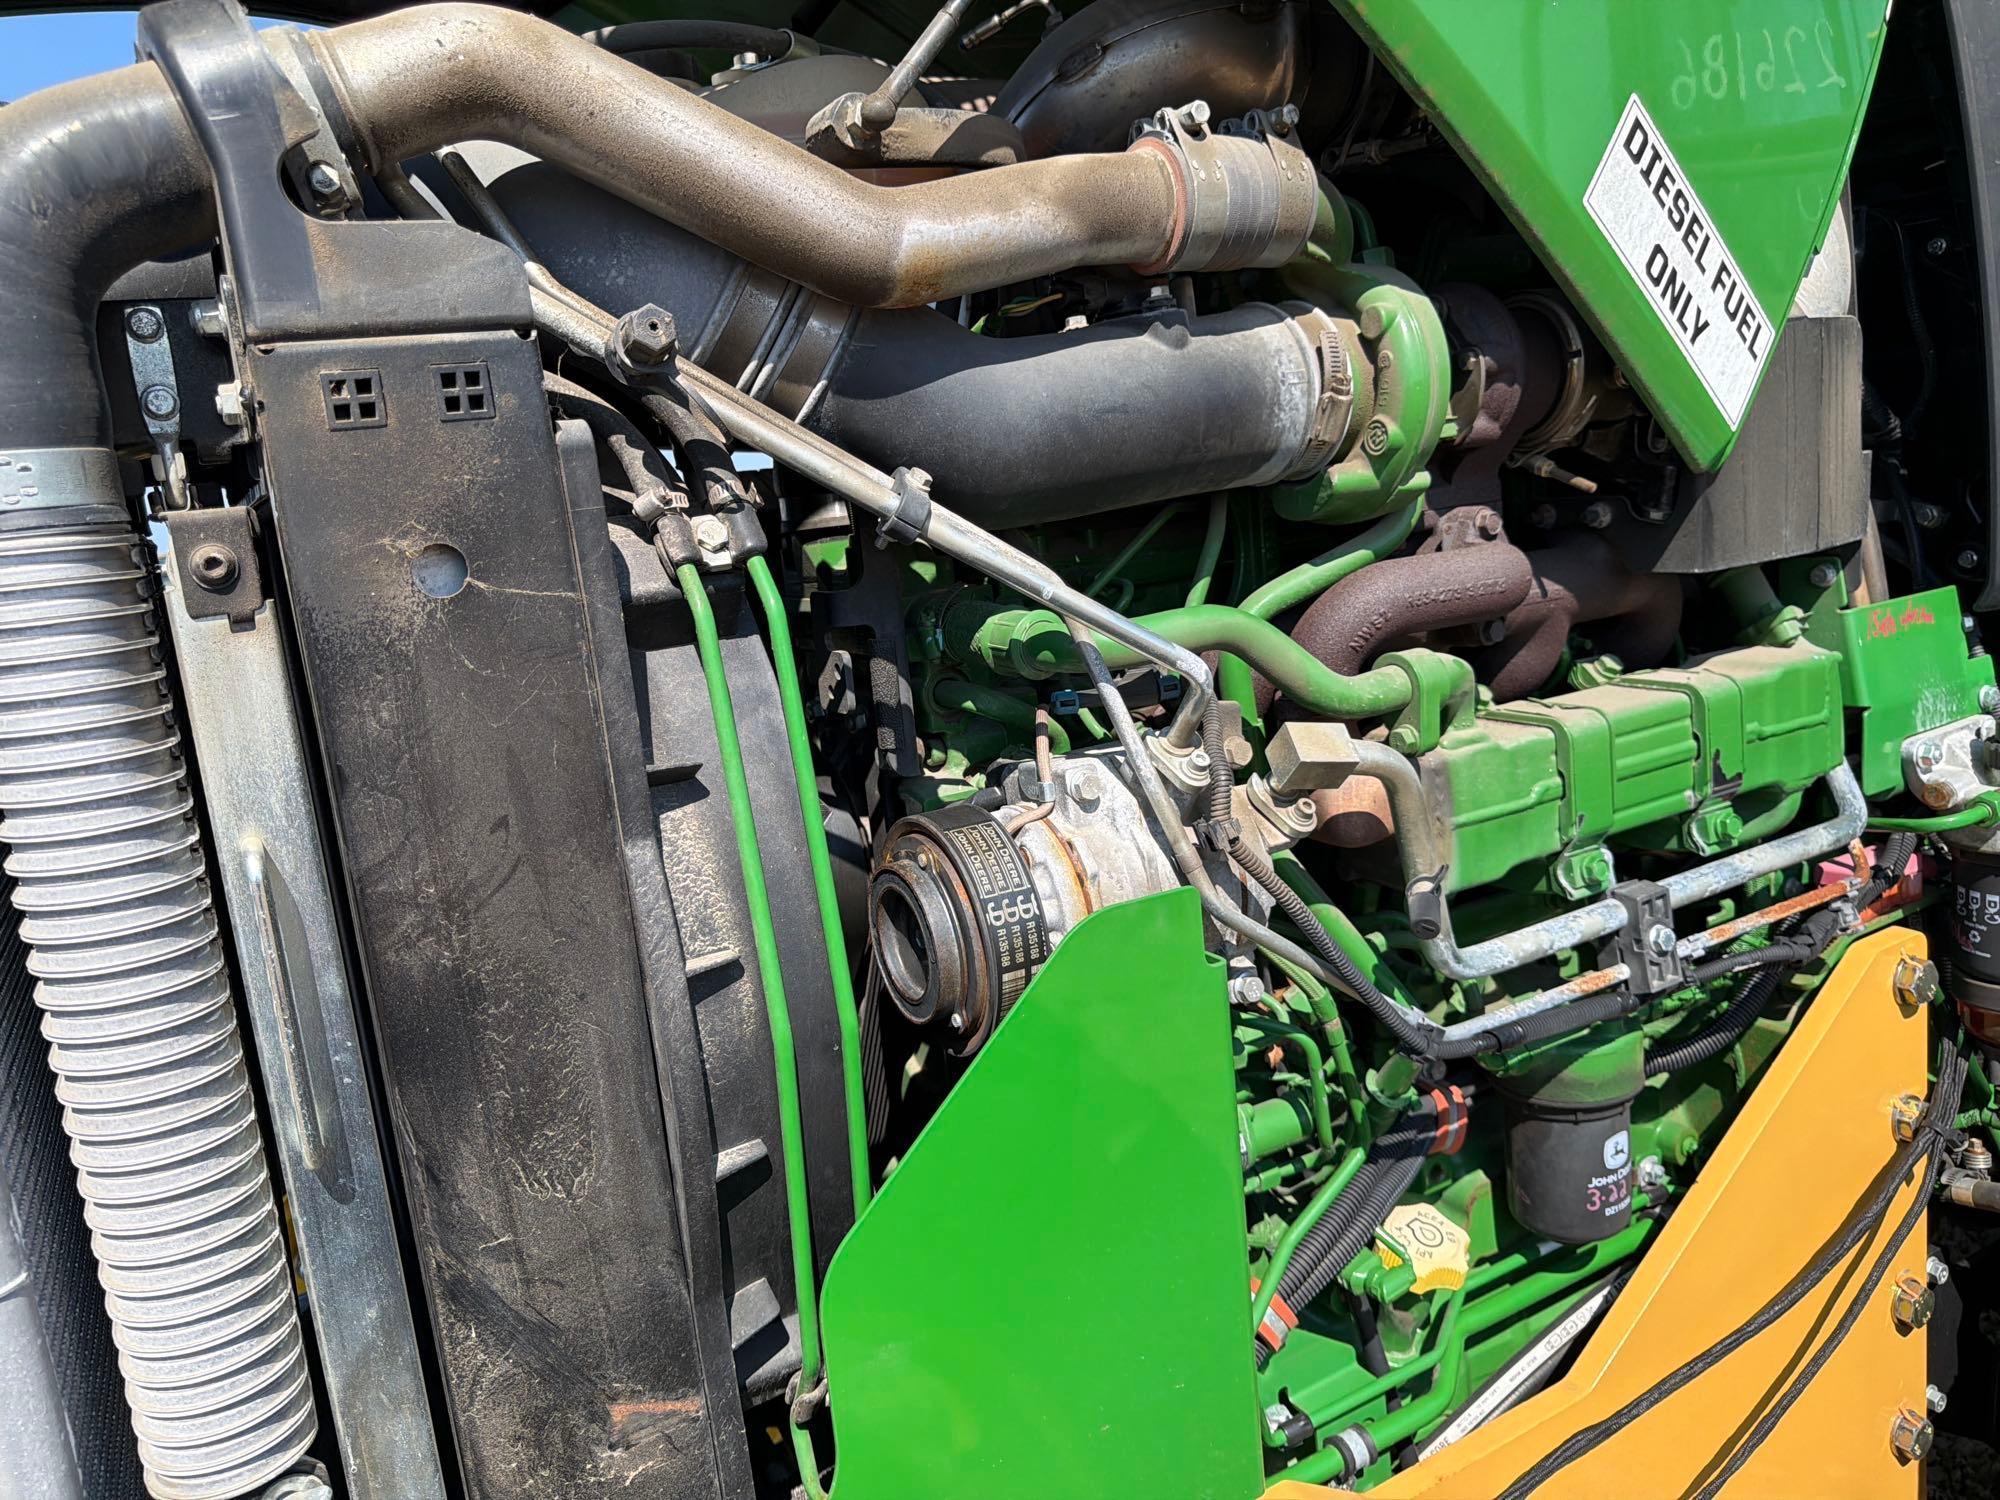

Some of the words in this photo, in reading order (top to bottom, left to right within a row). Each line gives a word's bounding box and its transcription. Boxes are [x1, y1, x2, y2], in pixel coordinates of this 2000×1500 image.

[1622, 116, 1712, 275] DIESEL
[1712, 260, 1763, 362] FUEL
[1645, 243, 1710, 347] ONLY
[955, 832, 975, 855] JOHN
[970, 854, 993, 893] DEERE
[970, 828, 989, 851] JOHN
[984, 850, 1007, 889] DEERE
[984, 825, 1004, 848] JOHN
[999, 847, 1022, 886] DEERE
[996, 928, 1011, 967] R135188
[1011, 924, 1025, 963] R135188
[1025, 921, 1040, 960] R135188
[1588, 1173, 1618, 1188] JOHN
